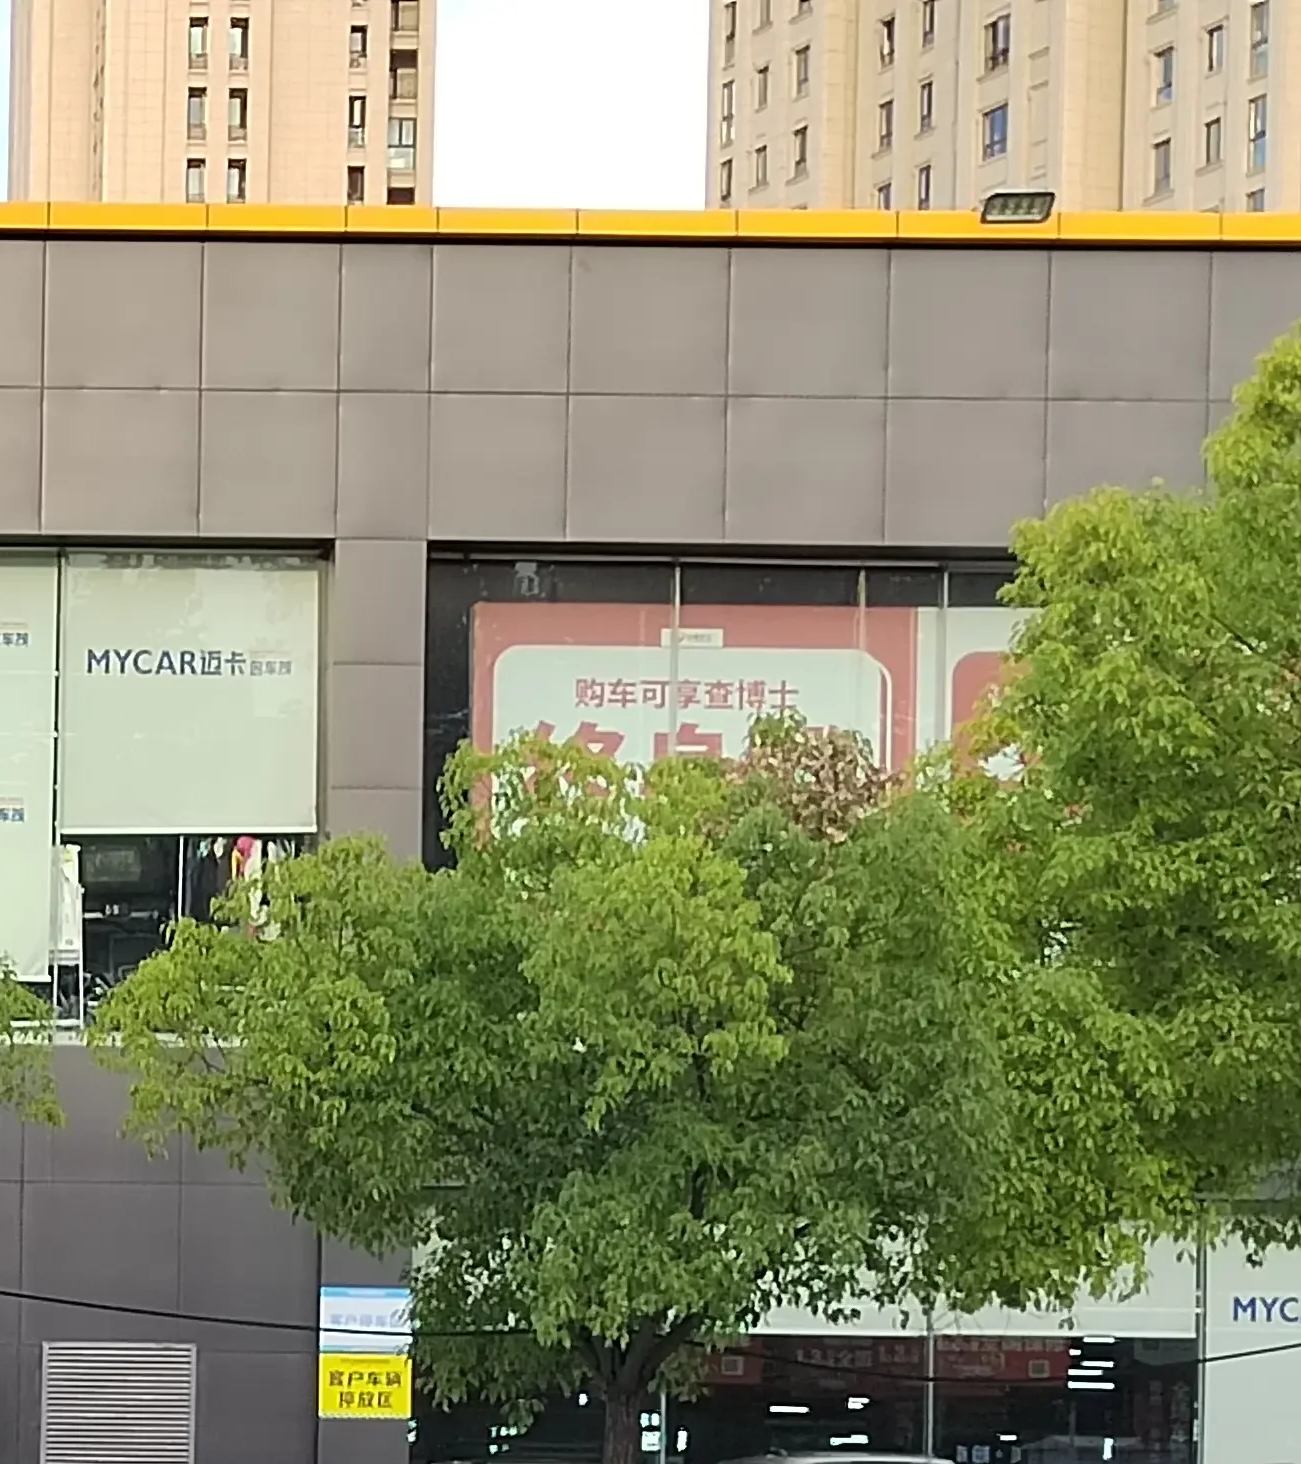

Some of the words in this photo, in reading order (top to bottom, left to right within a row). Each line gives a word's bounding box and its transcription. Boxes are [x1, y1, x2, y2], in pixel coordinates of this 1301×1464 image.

[575, 678, 799, 711] 购车可享查博士
